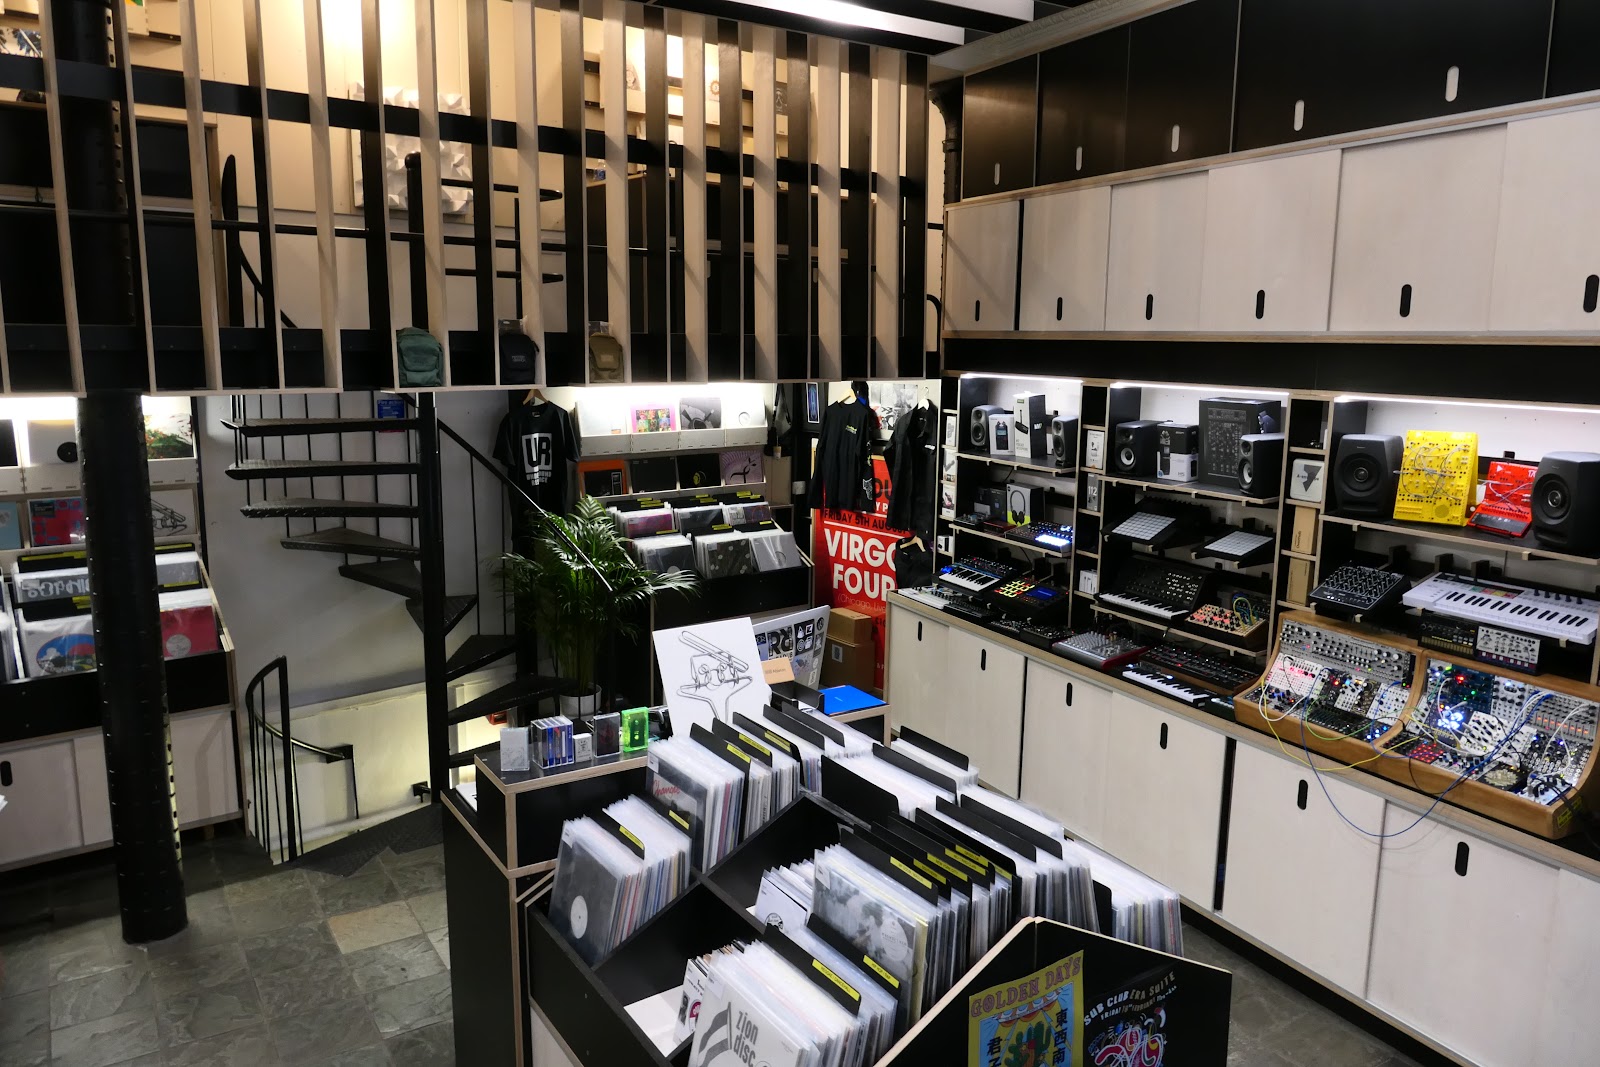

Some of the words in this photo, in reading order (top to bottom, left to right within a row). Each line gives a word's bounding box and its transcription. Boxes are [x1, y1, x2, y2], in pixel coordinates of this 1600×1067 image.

[525, 436, 551, 468] UR
[1087, 485, 1098, 496] 112
[824, 509, 853, 523] FRIDAY
[855, 514, 870, 527] 5TH
[970, 977, 1040, 1018] GOLDEN
[1083, 1003, 1104, 1026] SUB
[1106, 990, 1130, 1008] CLUB
[1149, 971, 1176, 997] SUITE
[1100, 1006, 1121, 1021] FRIDAY
[735, 1010, 759, 1046] zion
[733, 1032, 757, 1067] disc
